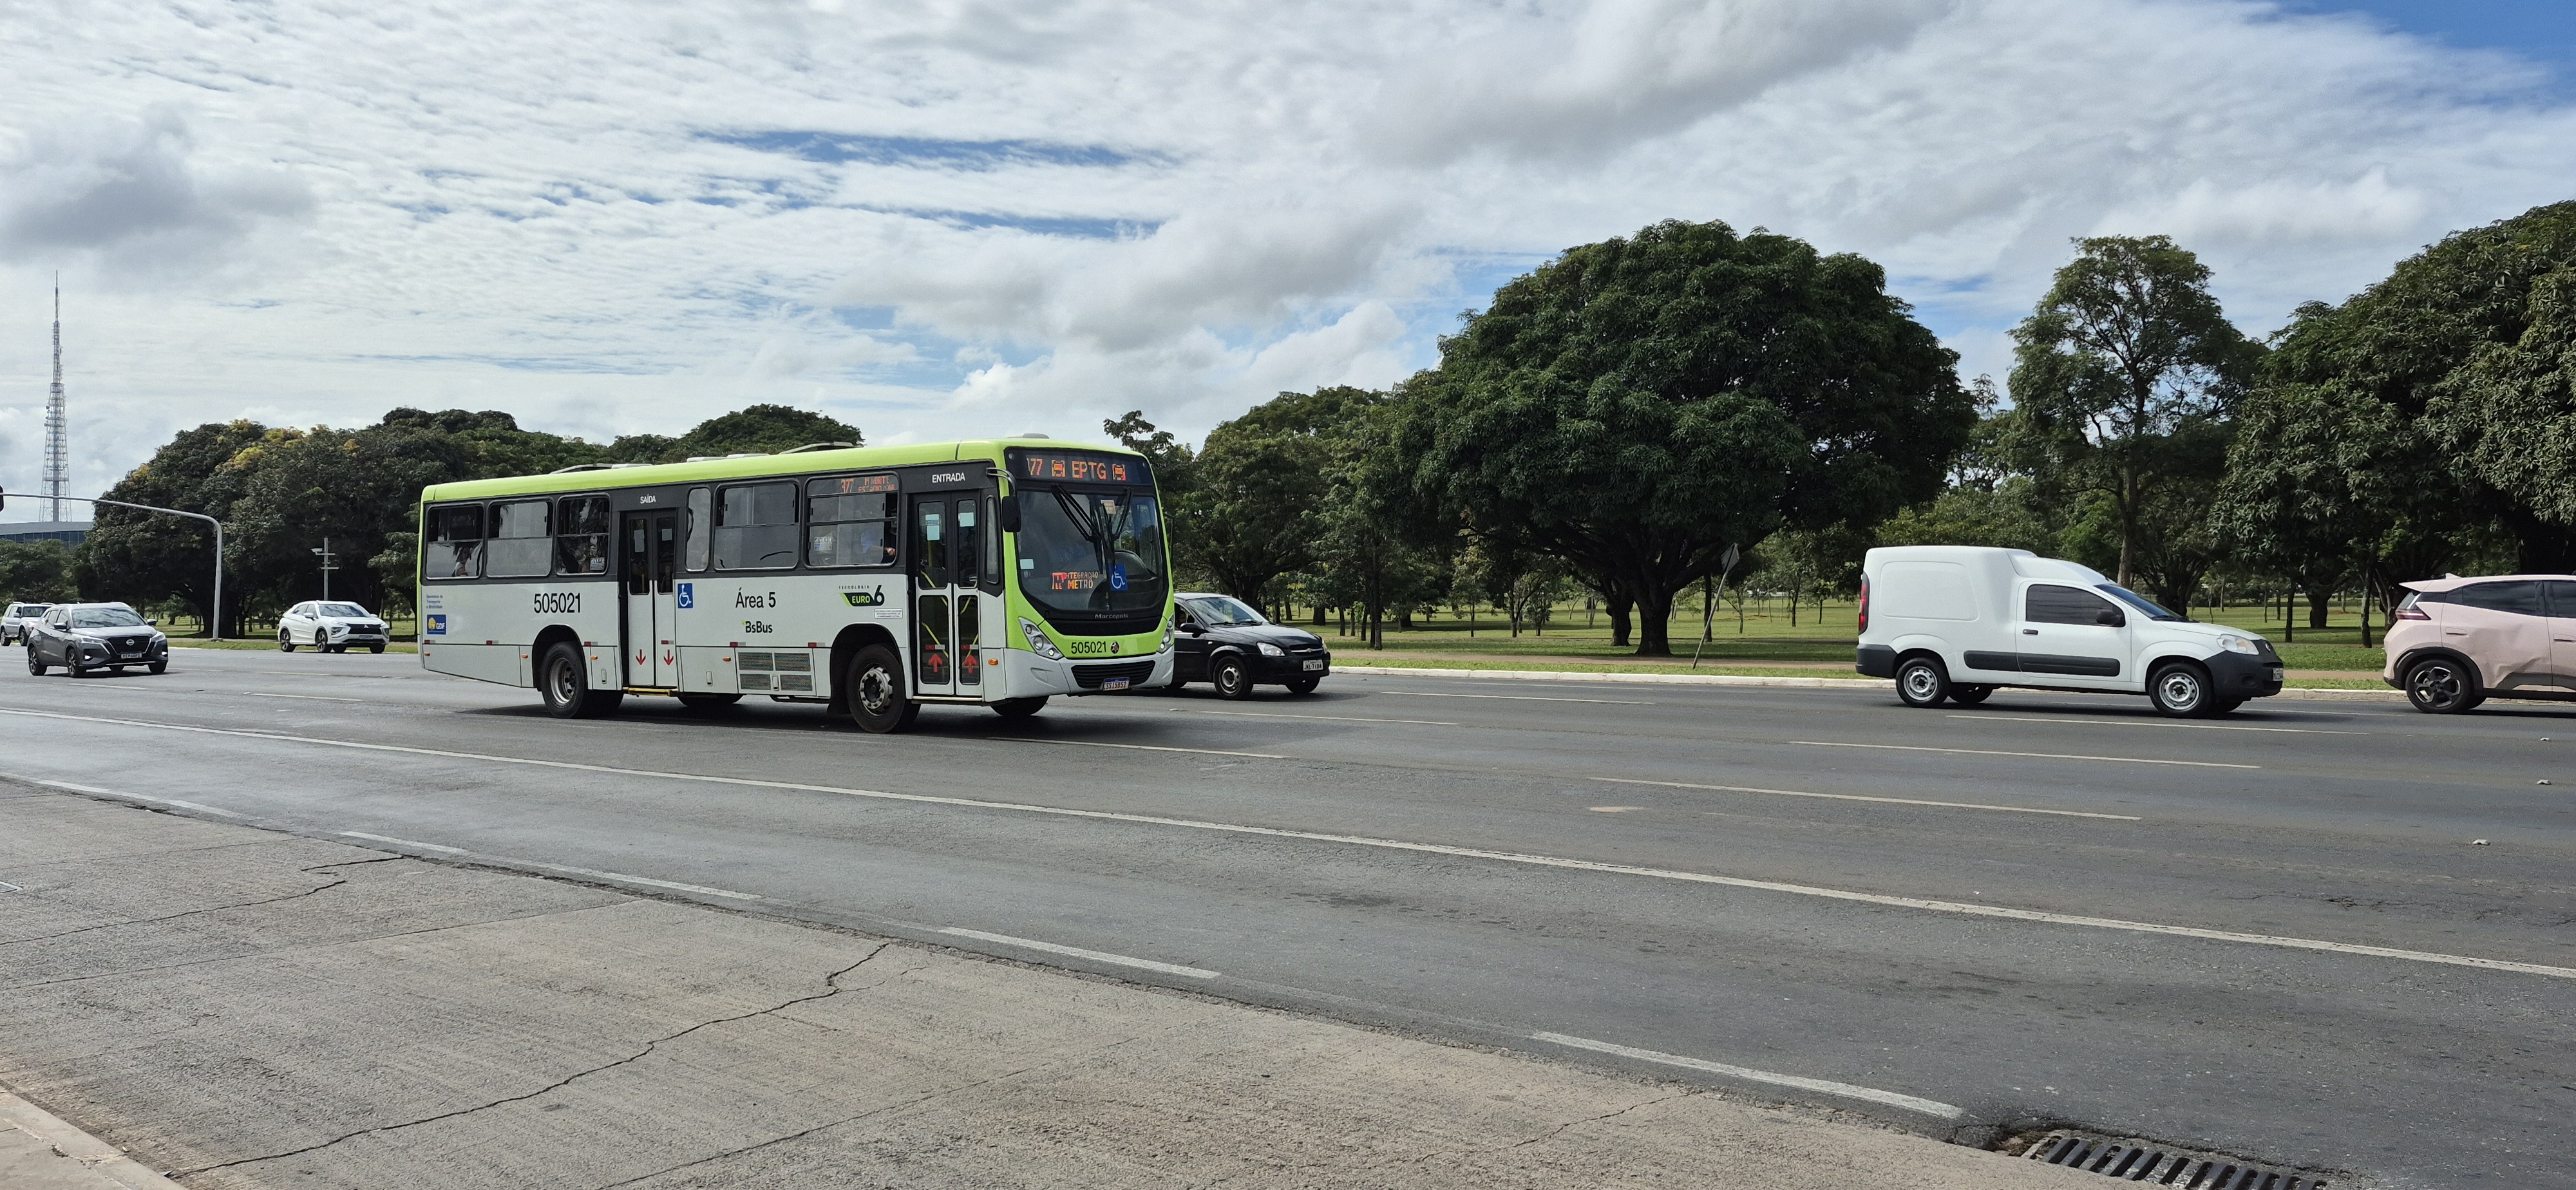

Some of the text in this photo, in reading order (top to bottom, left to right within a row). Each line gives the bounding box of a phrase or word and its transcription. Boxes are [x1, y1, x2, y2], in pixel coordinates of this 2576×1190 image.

[932, 472, 965, 483] ENTRADA
[1072, 460, 1107, 480] EPTG
[639, 494, 656, 504] SAÍDA
[533, 592, 581, 614] 505021
[735, 587, 776, 608] Área 5
[851, 584, 885, 607] EURO 6
[745, 620, 773, 634] BsBus
[1071, 641, 1107, 654] 505021
